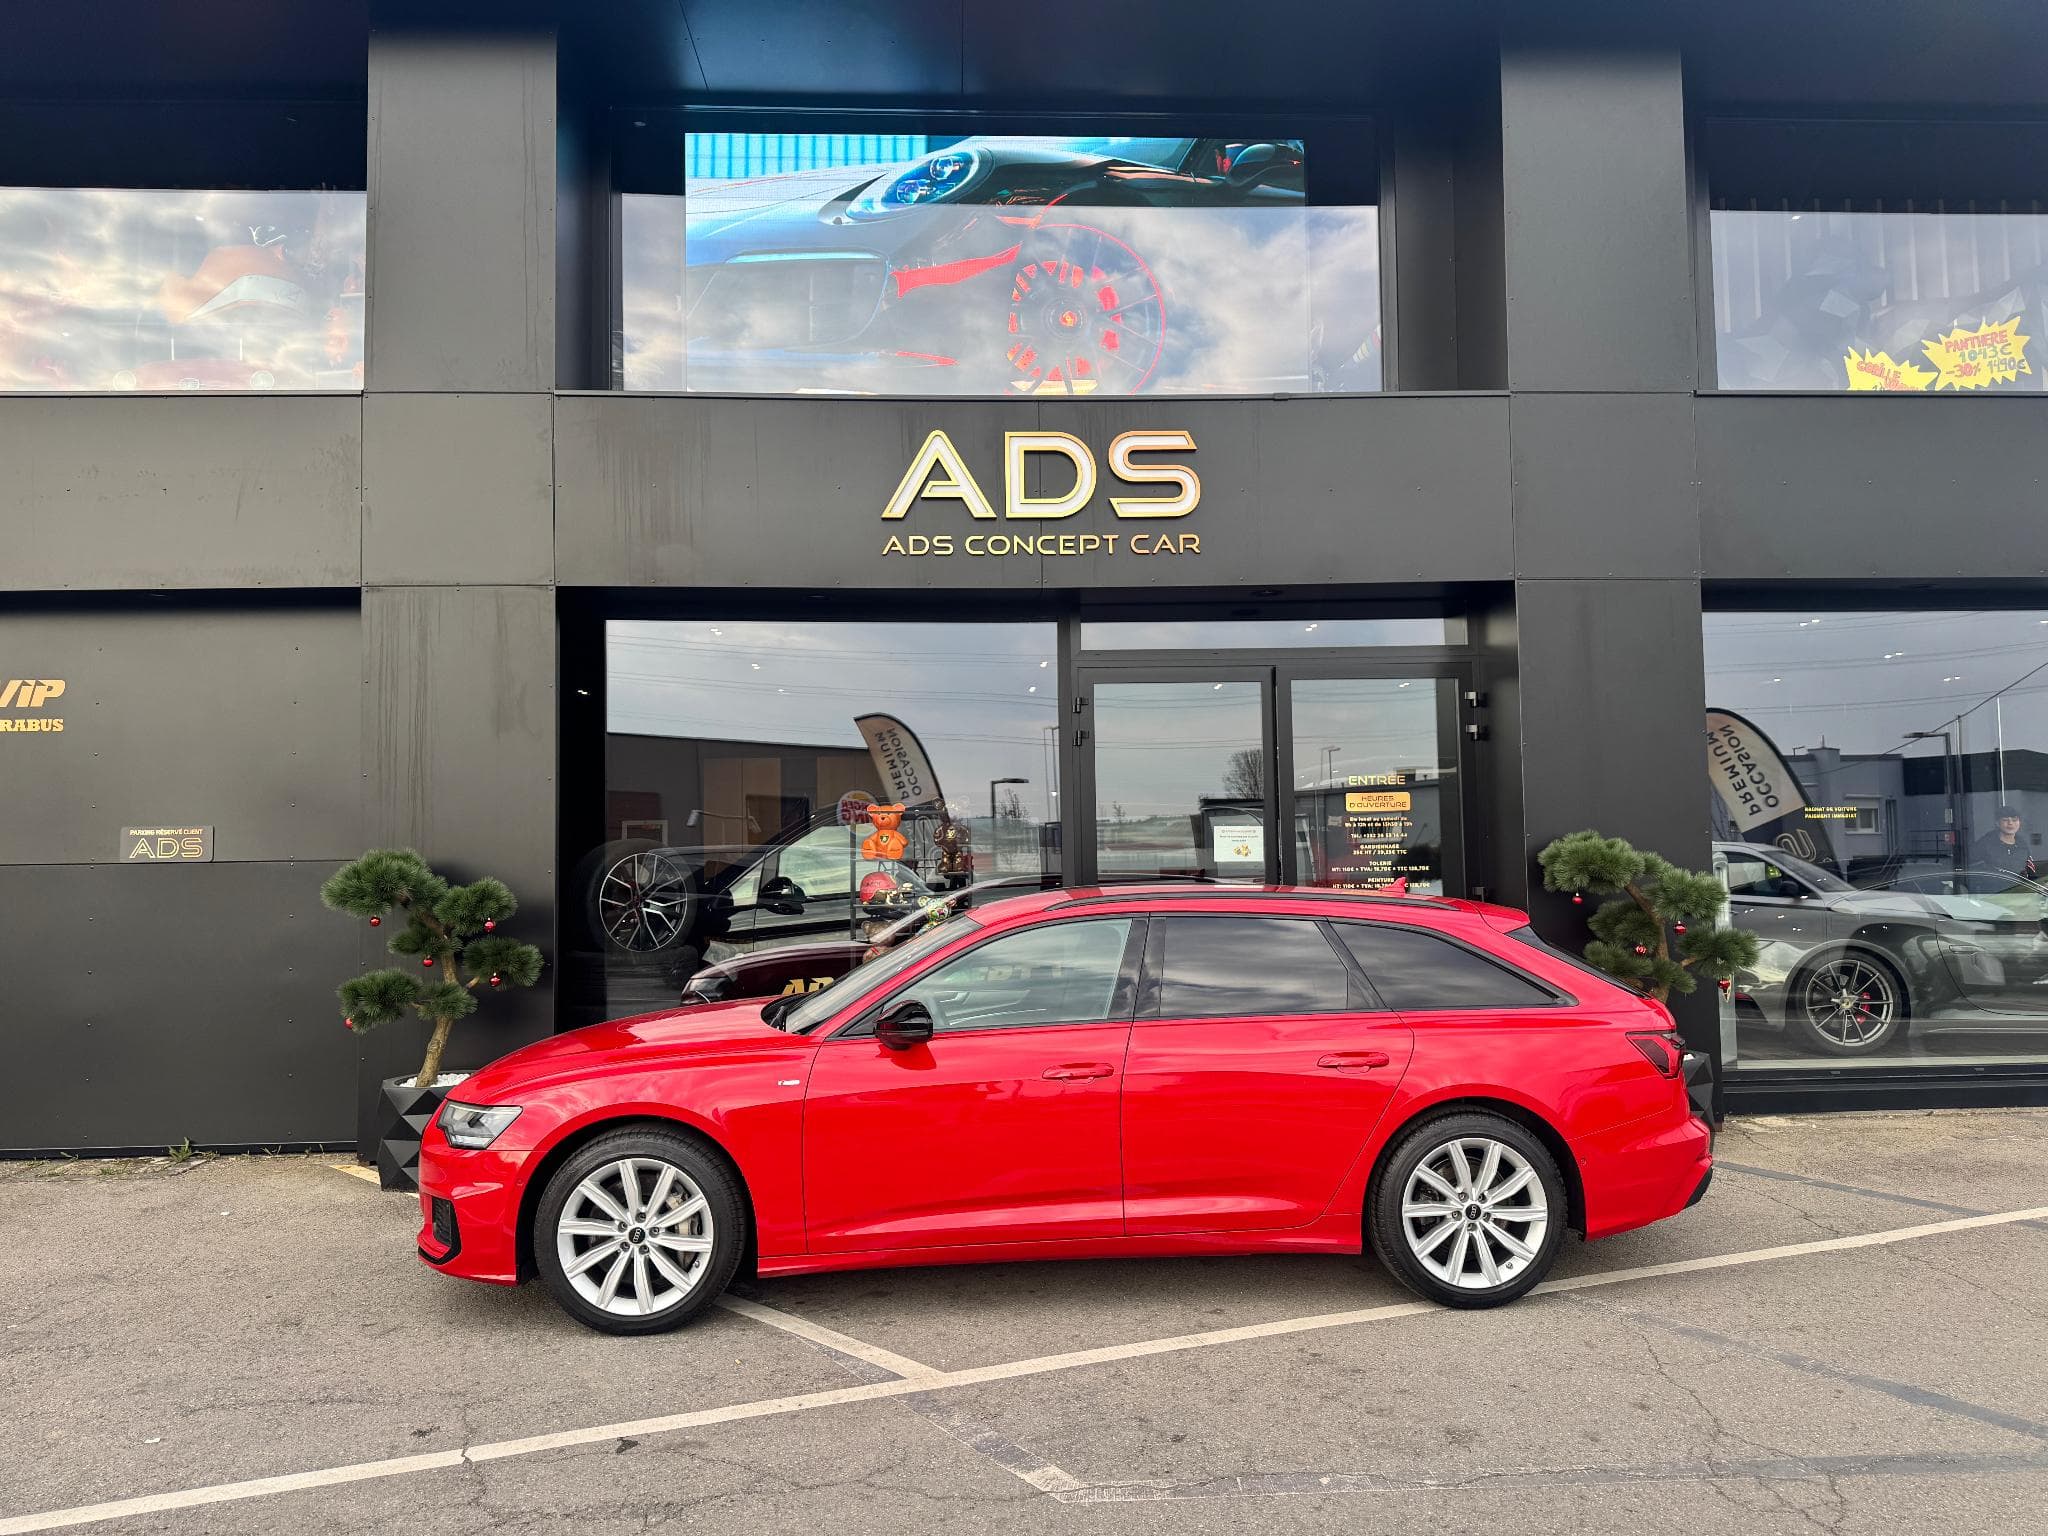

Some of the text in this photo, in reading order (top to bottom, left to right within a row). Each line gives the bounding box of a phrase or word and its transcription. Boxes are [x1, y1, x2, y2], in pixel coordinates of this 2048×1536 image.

[881, 429, 1201, 518] ADS
[881, 533, 1201, 556] ADS CONCEPT CAR
[0, 718, 64, 732] RABUS
[128, 837, 203, 859] ADS
